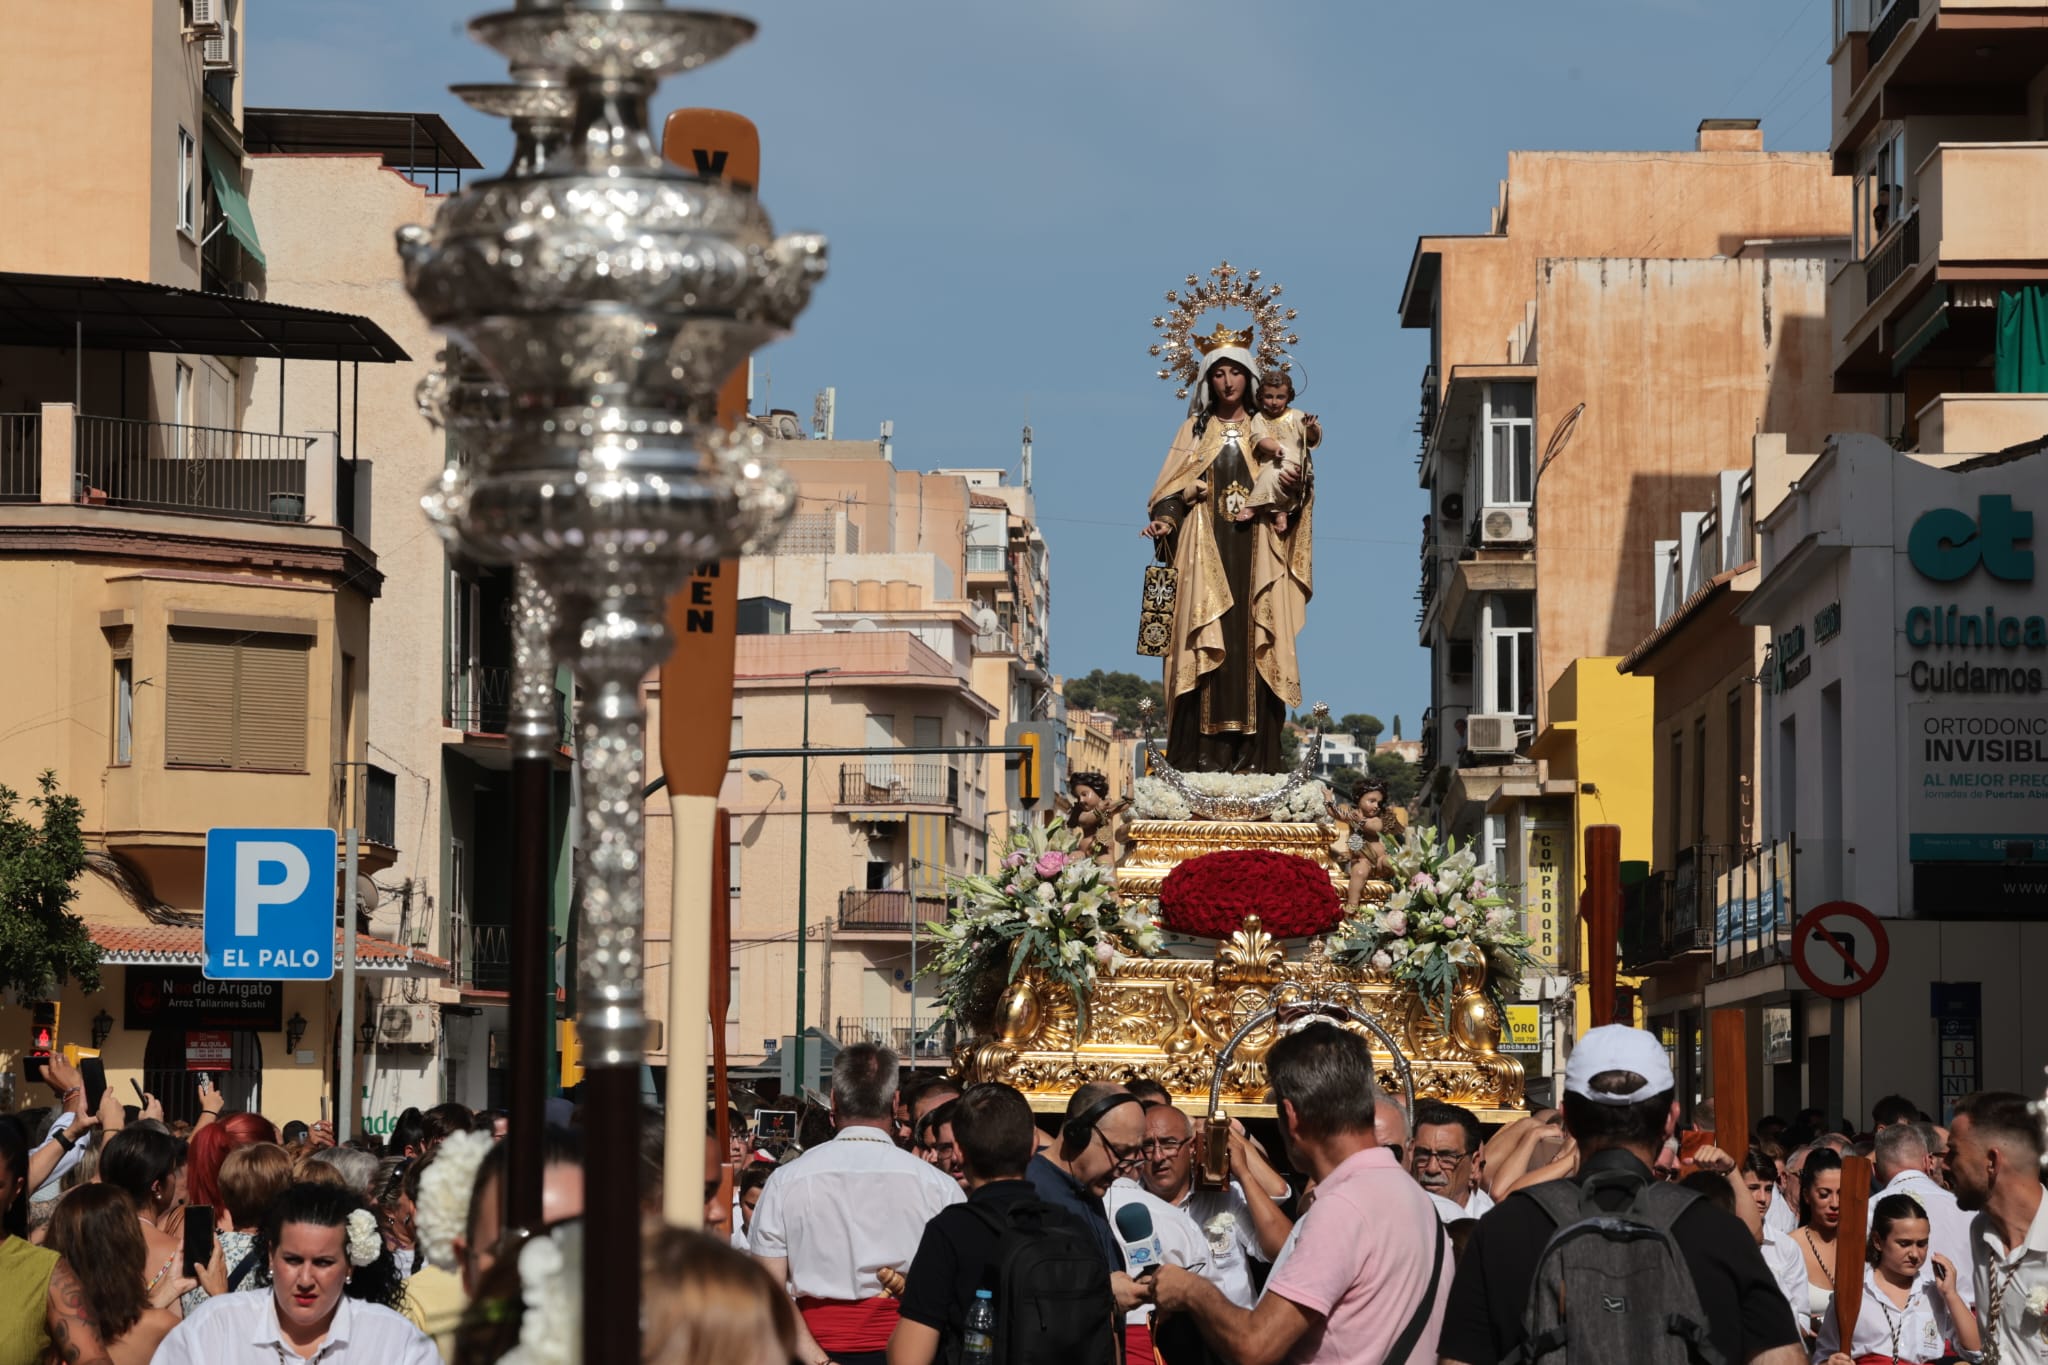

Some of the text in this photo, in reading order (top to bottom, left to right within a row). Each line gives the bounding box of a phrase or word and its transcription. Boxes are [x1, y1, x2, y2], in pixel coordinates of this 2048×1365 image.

[1905, 604, 2048, 649] Clínica
[1910, 660, 2043, 694] Cuidamos
[1924, 717, 2048, 736] ORTODONC
[1925, 739, 2048, 763] INVISIBL
[1923, 773, 1945, 787] AL
[1950, 773, 2004, 788] MEJOR
[1985, 789, 2024, 799] Puertas
[1540, 835, 1552, 913] COMPRO
[235, 841, 310, 936] P
[1541, 918, 1552, 956] ORO
[223, 949, 320, 968] EL PALO
[218, 981, 272, 998] Arigato
[168, 998, 265, 1009] Arroz Tallarines Sushi
[1513, 1023, 1535, 1033] ORO
[1954, 1042, 1964, 1057] 8
[1950, 1060, 1967, 1075] 11
[1947, 1078, 1968, 1094] N1
